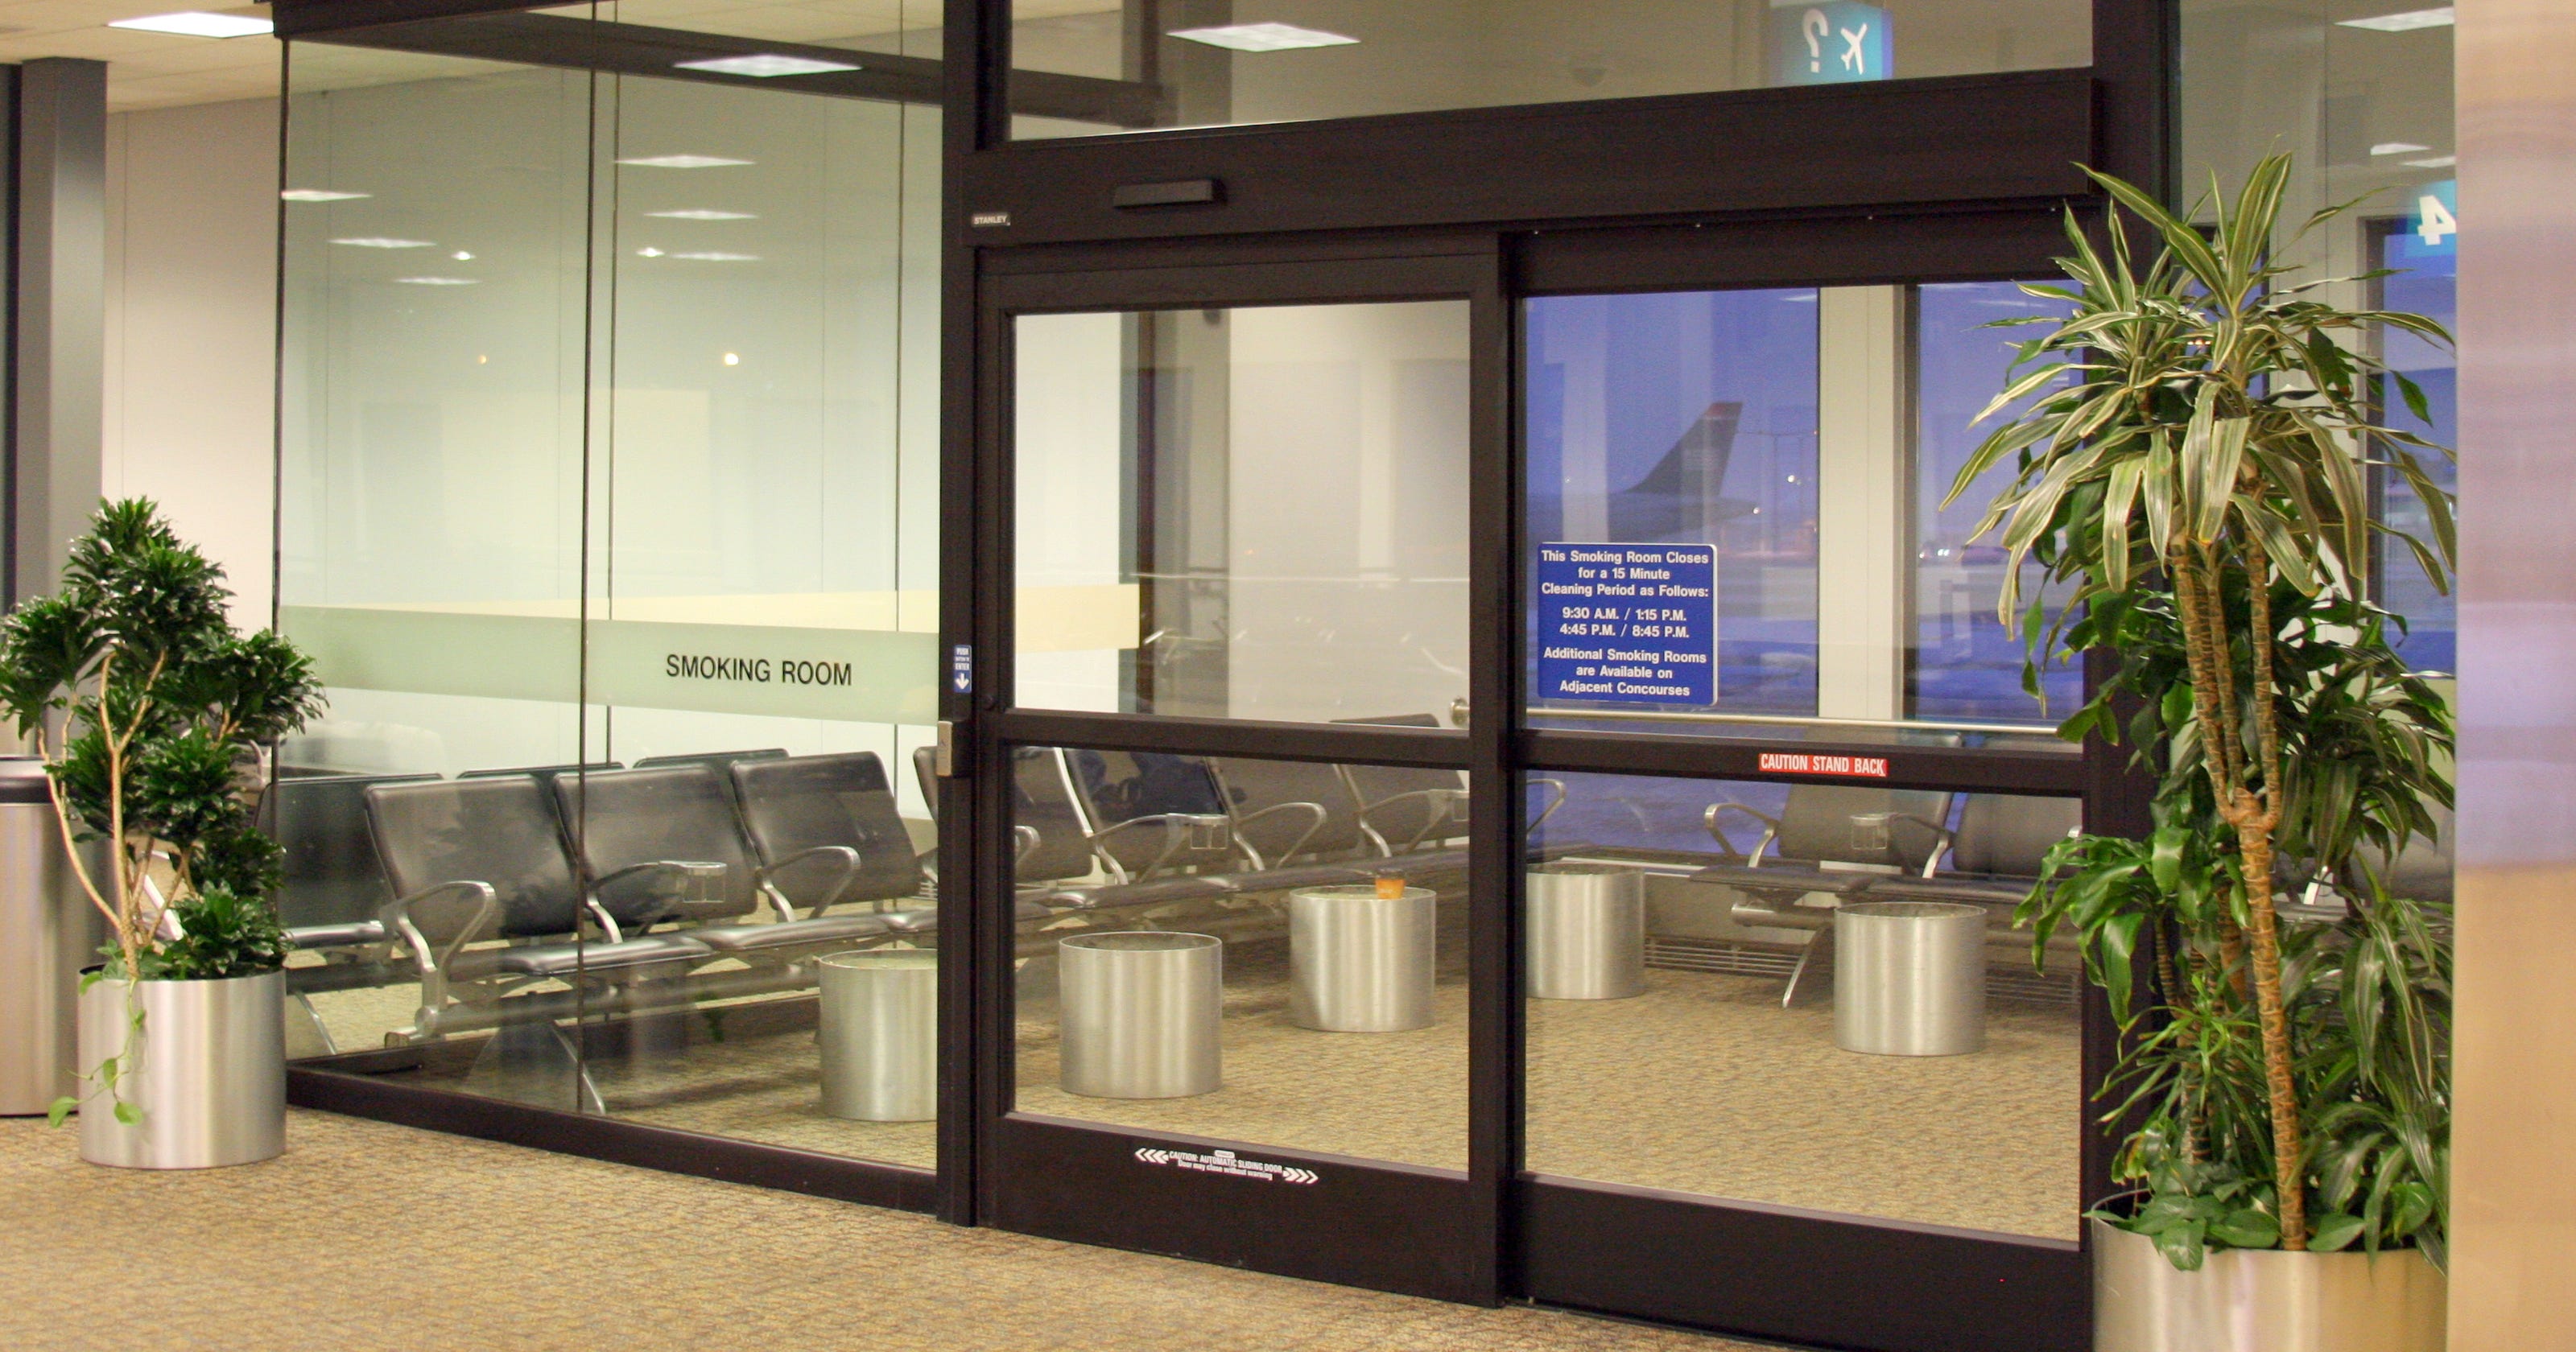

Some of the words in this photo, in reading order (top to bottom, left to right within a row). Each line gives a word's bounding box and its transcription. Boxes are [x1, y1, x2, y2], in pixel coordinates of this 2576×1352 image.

[973, 216, 1007, 225] STANLEY
[1542, 550, 1566, 562] This
[1571, 550, 1622, 564] Smoking
[1626, 551, 1662, 563] Room
[1666, 551, 1709, 563] Closes
[1578, 567, 1595, 579] for
[1600, 570, 1608, 579] a
[1612, 568, 1625, 579] 15
[1630, 568, 1670, 579] Minute
[1542, 583, 1592, 596] Cleaning
[1597, 584, 1635, 596] Period
[1640, 587, 1654, 596] as
[1658, 585, 1709, 597] Follows:
[1563, 607, 1590, 619] 9:30
[1594, 608, 1619, 620] A.M.
[1624, 608, 1630, 620] /
[1635, 609, 1657, 620] 1:15
[1662, 609, 1686, 621] P.M.
[1559, 624, 1587, 635] 4:45
[1591, 624, 1616, 636] P.M.
[1620, 624, 1627, 637] /
[1632, 625, 1660, 637] 8:45
[1664, 626, 1690, 638] P.M.
[1543, 647, 1603, 660] Additional
[1607, 649, 1659, 663] Smoking
[1664, 651, 1707, 663] Rooms
[666, 653, 770, 682] SMOKING
[782, 661, 852, 686] ROOM
[1576, 667, 1595, 676] are
[1600, 666, 1652, 678] Available
[1657, 670, 1673, 678] on
[1559, 681, 1612, 695] Adjacent
[1616, 682, 1690, 696] Concourses
[1761, 753, 1808, 770] CAUTION
[1813, 756, 1849, 773] STAND
[1854, 758, 1885, 774] BACK
[1200, 1155, 1237, 1168] AUTOMATIC
[1237, 1160, 1263, 1171] SLIDING
[1264, 1164, 1282, 1174] DOOR
